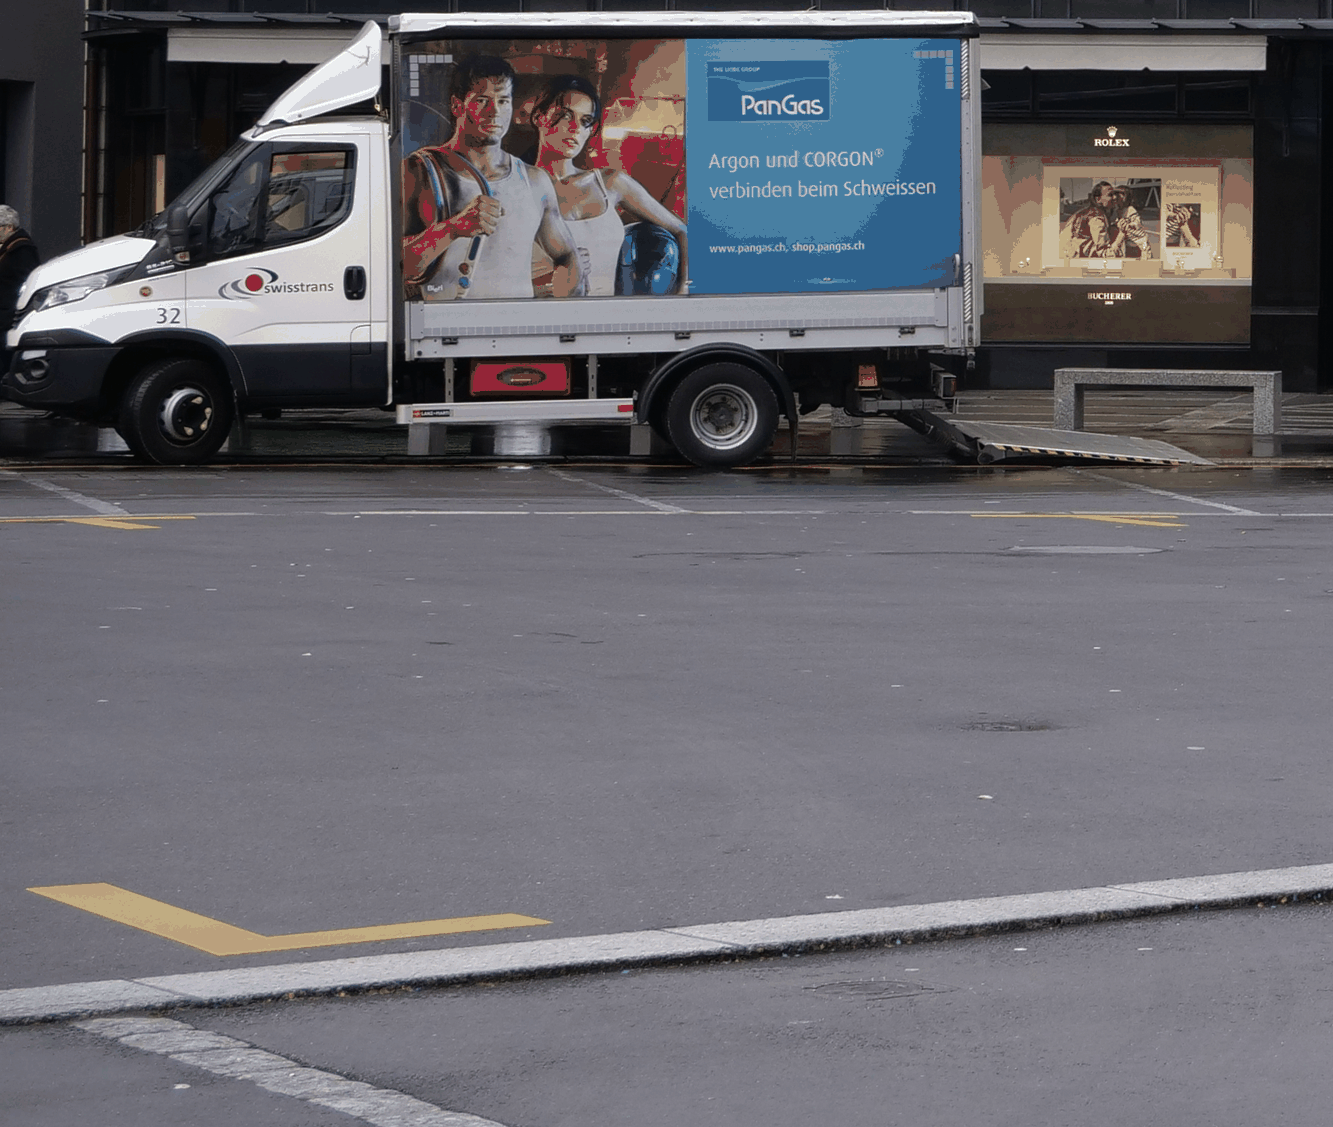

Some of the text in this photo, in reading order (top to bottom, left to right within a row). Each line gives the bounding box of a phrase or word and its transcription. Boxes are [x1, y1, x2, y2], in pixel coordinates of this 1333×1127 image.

[741, 93, 824, 115] PanGas
[1093, 138, 1130, 147] ROLEX
[708, 153, 760, 173] Argon
[766, 150, 798, 168] und
[709, 179, 937, 199] verbinden beim Schweissen
[709, 240, 865, 255] www.pangas.ch, shop.pangas.ch
[264, 280, 335, 294] swisstrans
[1087, 292, 1132, 301] BUCHERER
[156, 307, 181, 324] 32
